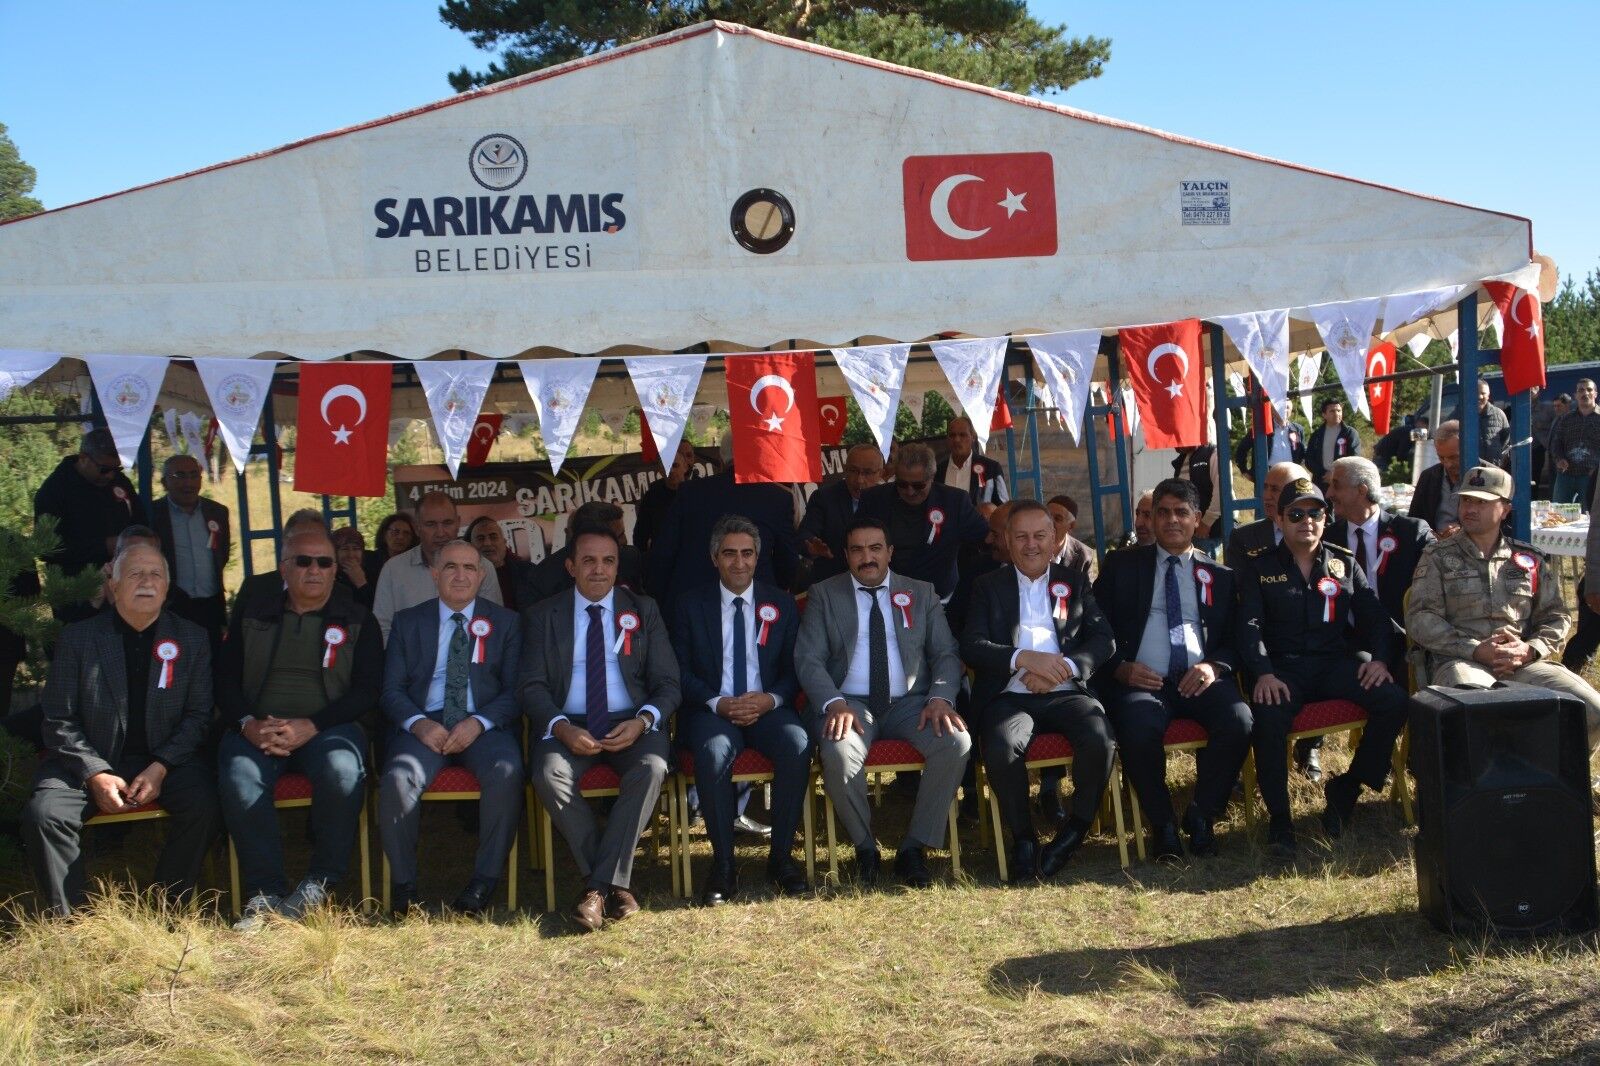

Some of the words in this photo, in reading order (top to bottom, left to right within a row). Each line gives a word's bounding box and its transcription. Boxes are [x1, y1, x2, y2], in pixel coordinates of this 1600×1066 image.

[1182, 182, 1228, 191] YALÇIN
[374, 192, 627, 239] SARIKAMIŞ
[408, 485, 421, 502] 4
[467, 480, 508, 499] 2024
[515, 471, 664, 517] SARIKAM
